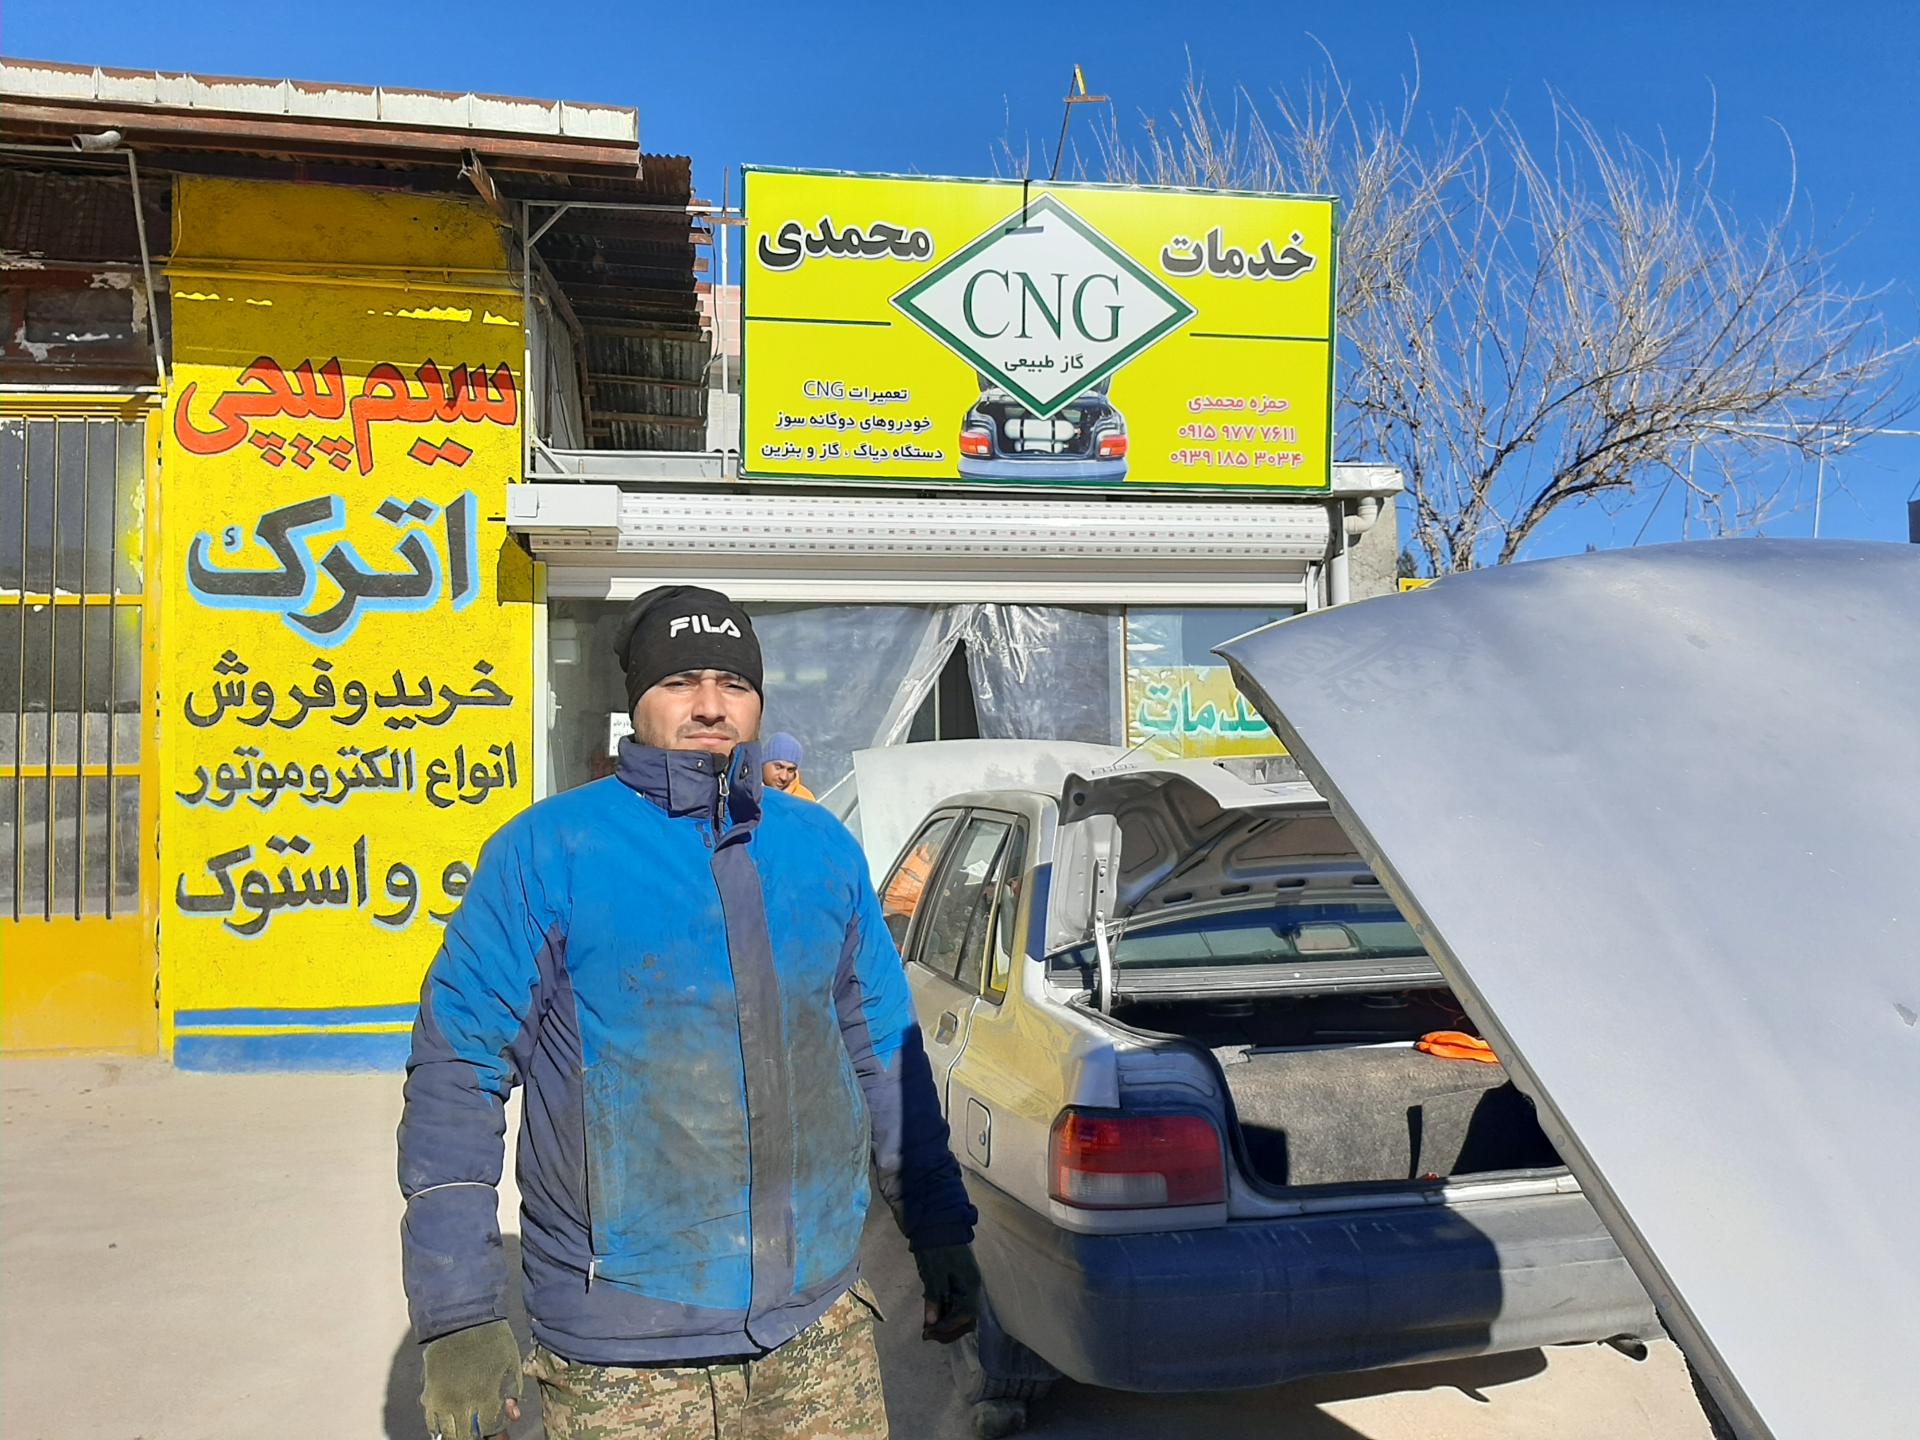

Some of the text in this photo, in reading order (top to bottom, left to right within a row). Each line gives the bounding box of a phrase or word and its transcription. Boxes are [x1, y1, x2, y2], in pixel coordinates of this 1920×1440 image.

[758, 216, 1314, 278] خدمات محمدی
[962, 269, 1125, 343] CNG
[1004, 353, 1084, 373] گاز طبیعی
[803, 379, 908, 402] تعمیرات CNG
[1188, 395, 1288, 414] حمزه محمدی
[775, 411, 931, 432] خودروهای دوگانه سوز
[1178, 423, 1296, 442] ۰۹۱۵ ۹۷۷ ۷۶۱۱
[761, 441, 802, 458] بنزین
[807, 445, 814, 459] و
[820, 442, 840, 459] گاز
[852, 442, 888, 461] دیاگ
[891, 445, 943, 460] دستگاه
[1169, 449, 1303, 468] ۰۹۳۹ ۱۸۵ ۳۰۳۴
[669, 614, 742, 638] FILA
[175, 741, 518, 809] انواع الکتروموتور
[175, 834, 369, 936] استوک
